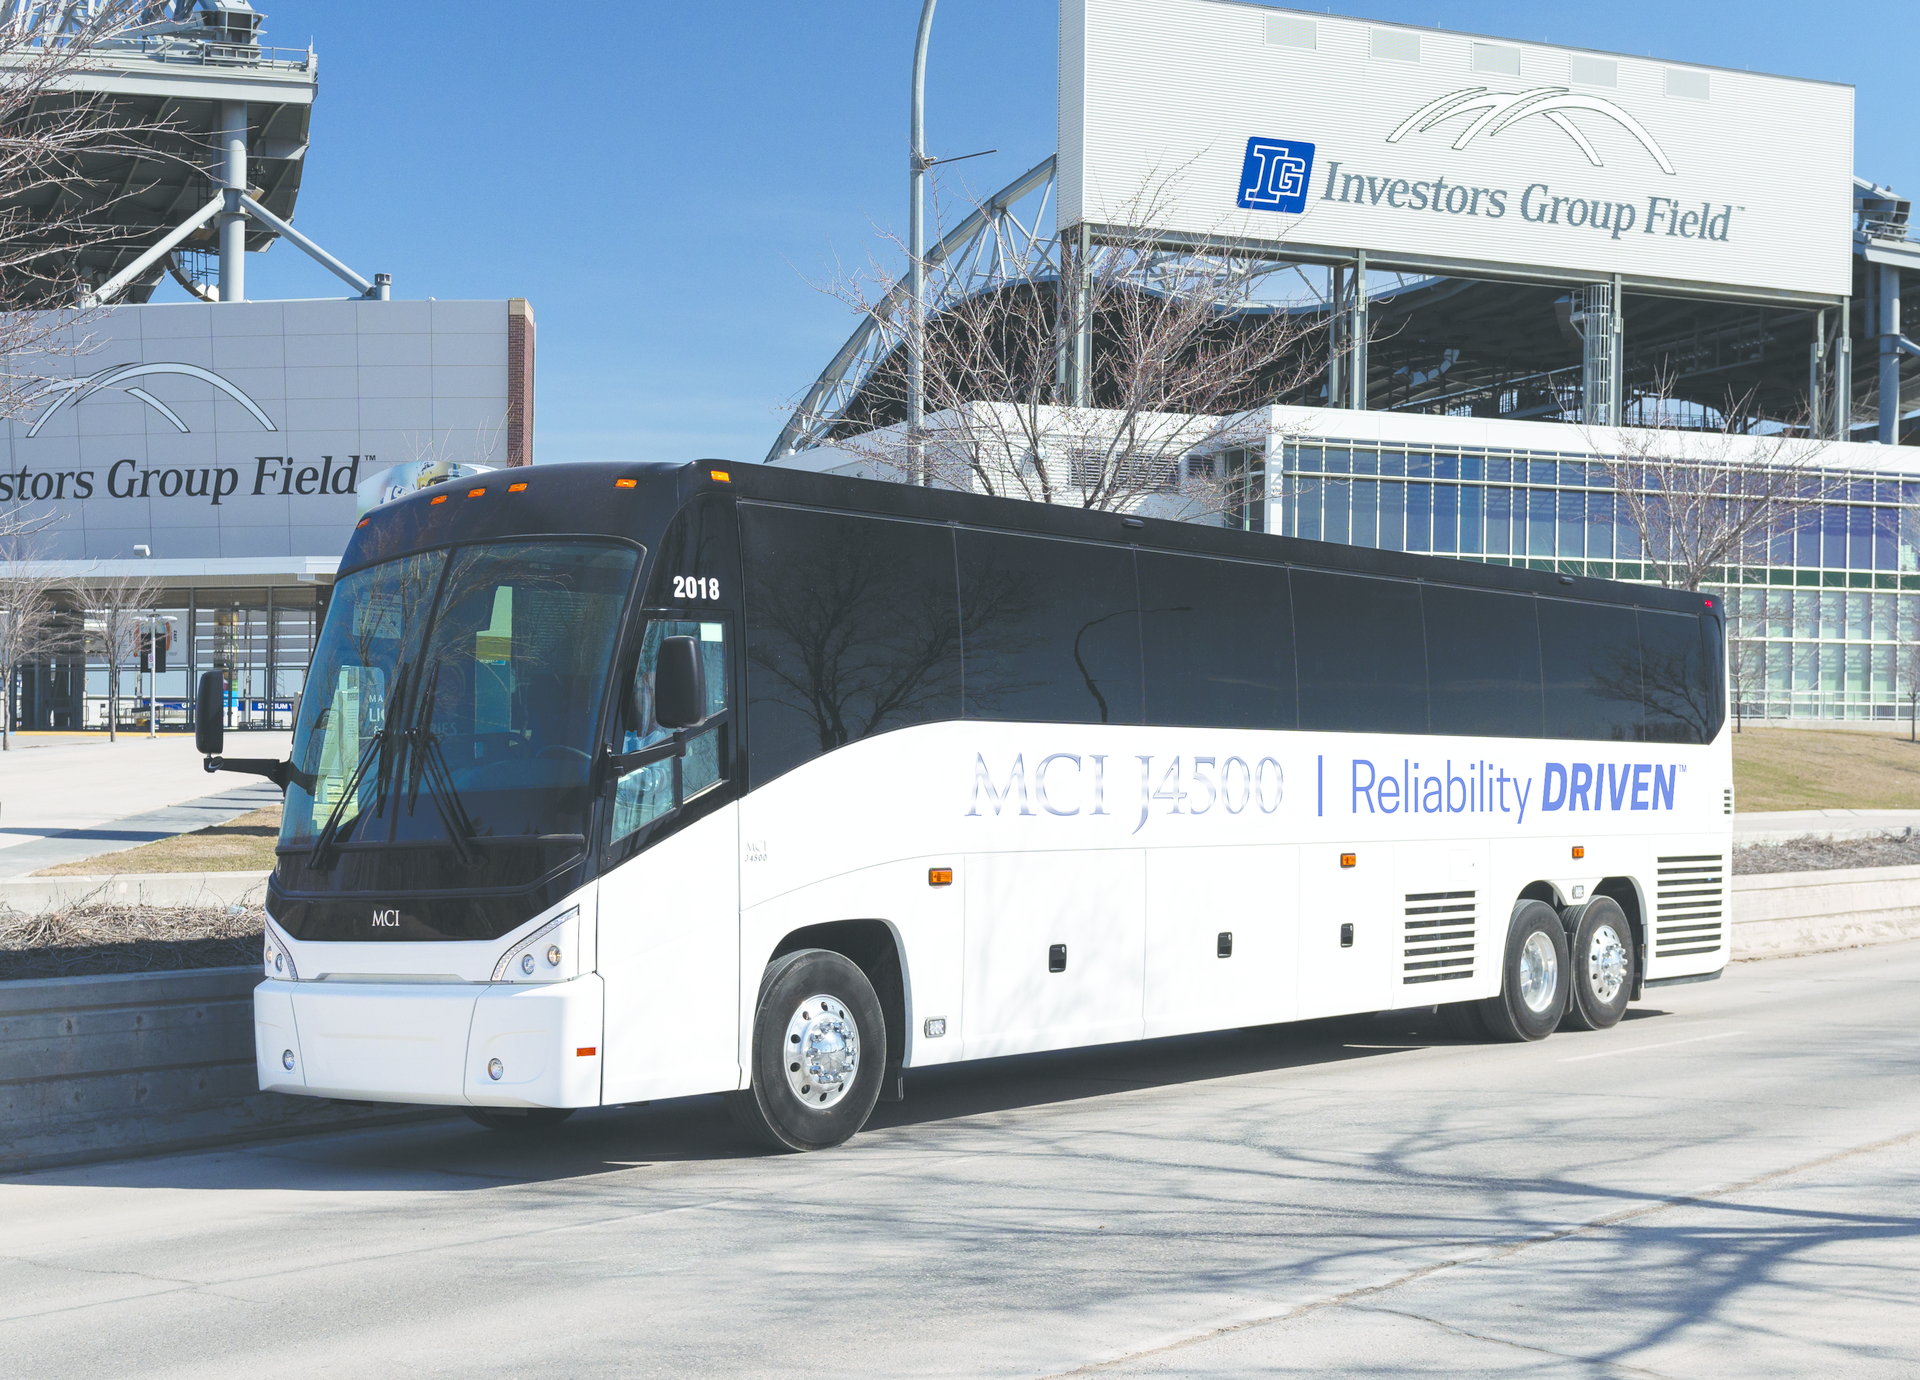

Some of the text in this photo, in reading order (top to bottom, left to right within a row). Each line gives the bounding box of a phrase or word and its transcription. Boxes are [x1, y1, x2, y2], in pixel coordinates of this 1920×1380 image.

[1246, 144, 1306, 204] IG
[1320, 161, 1508, 219] Investors
[1520, 183, 1636, 240] Group
[1643, 196, 1732, 242] Field
[107, 459, 239, 506] Group
[250, 455, 360, 496] Field
[673, 575, 720, 600] 2018
[964, 752, 1111, 816] MCI
[1132, 755, 1284, 835] J4500
[1352, 759, 1532, 824] Reliability
[1541, 762, 1677, 811] DRIVEN
[745, 840, 767, 852] MCI
[371, 909, 400, 927] MCI
